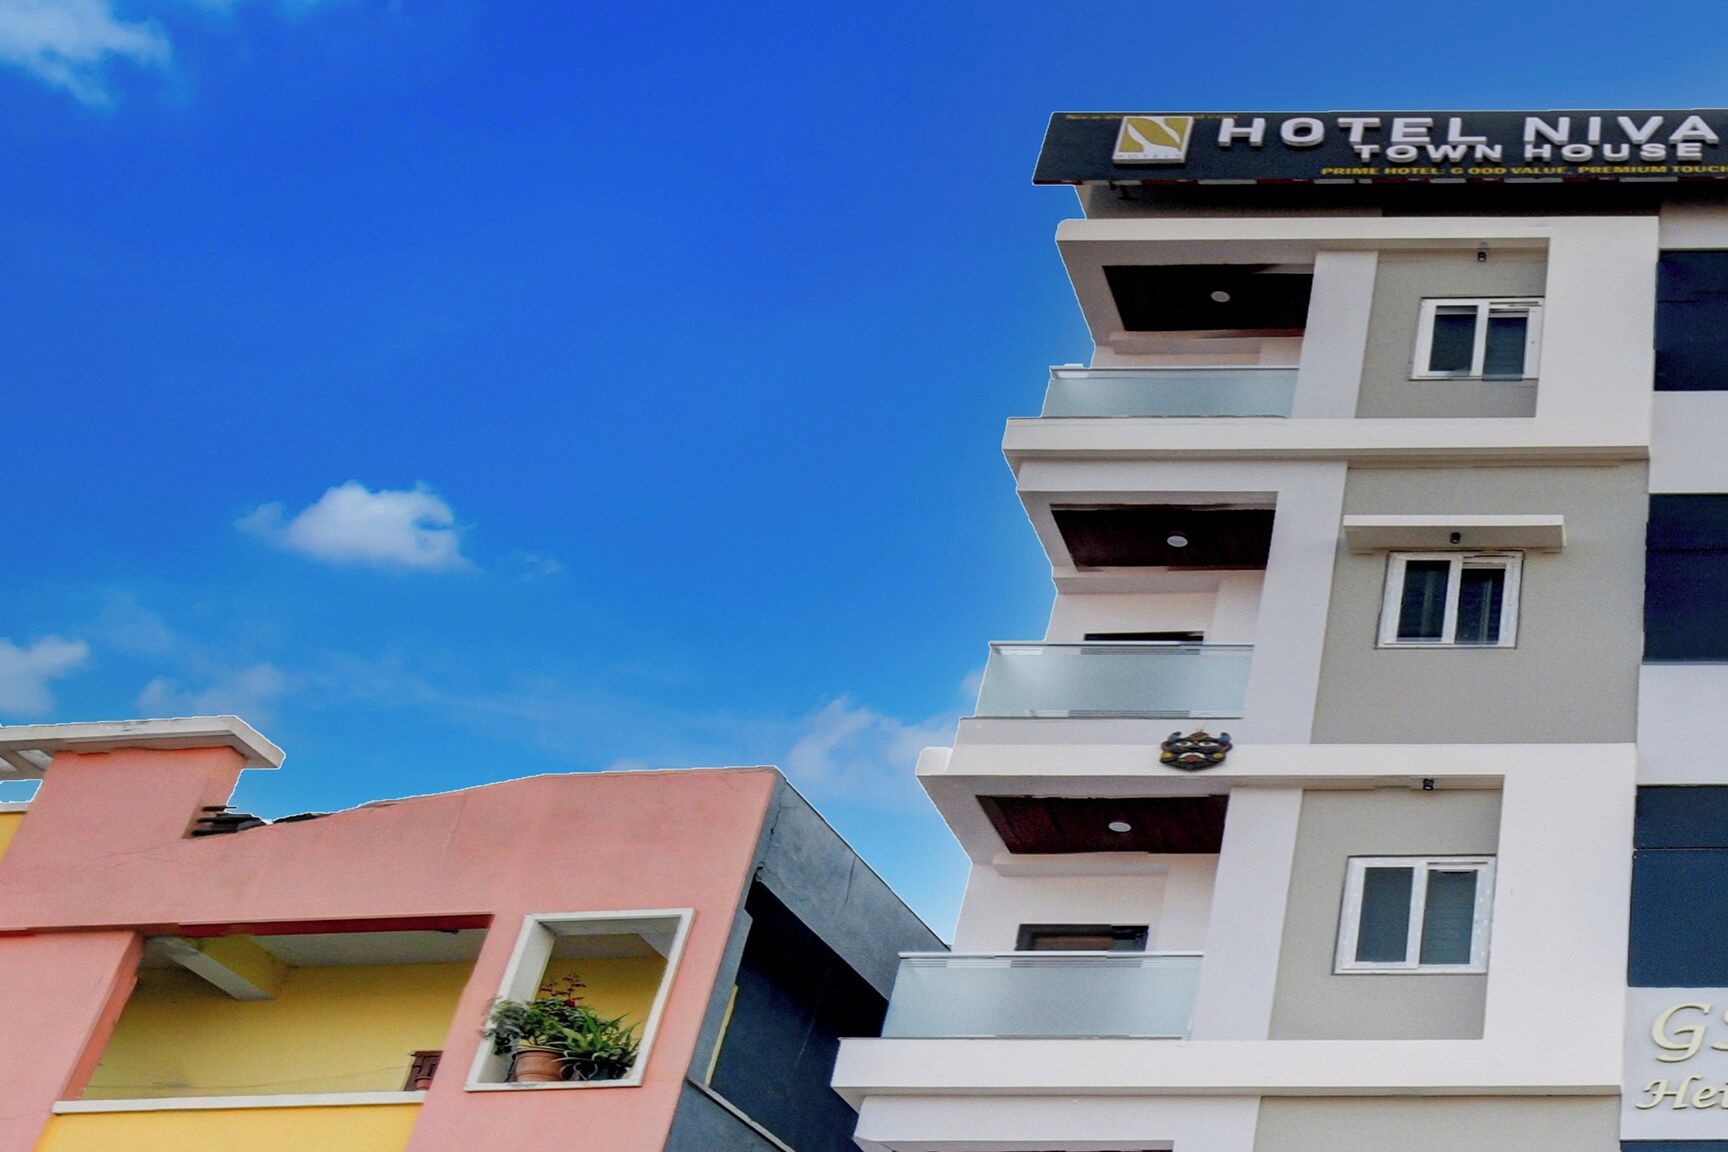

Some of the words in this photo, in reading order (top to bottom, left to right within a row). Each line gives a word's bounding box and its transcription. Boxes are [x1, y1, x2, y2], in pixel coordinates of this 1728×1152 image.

[1218, 116, 1488, 147] HOTEL
[1353, 144, 1503, 163] TOWN
[1524, 142, 1703, 163] HOUSE
[1321, 167, 1379, 175] PRIME
[1384, 167, 1445, 175] HOTEL:
[1577, 165, 1667, 174] PREMIUM
